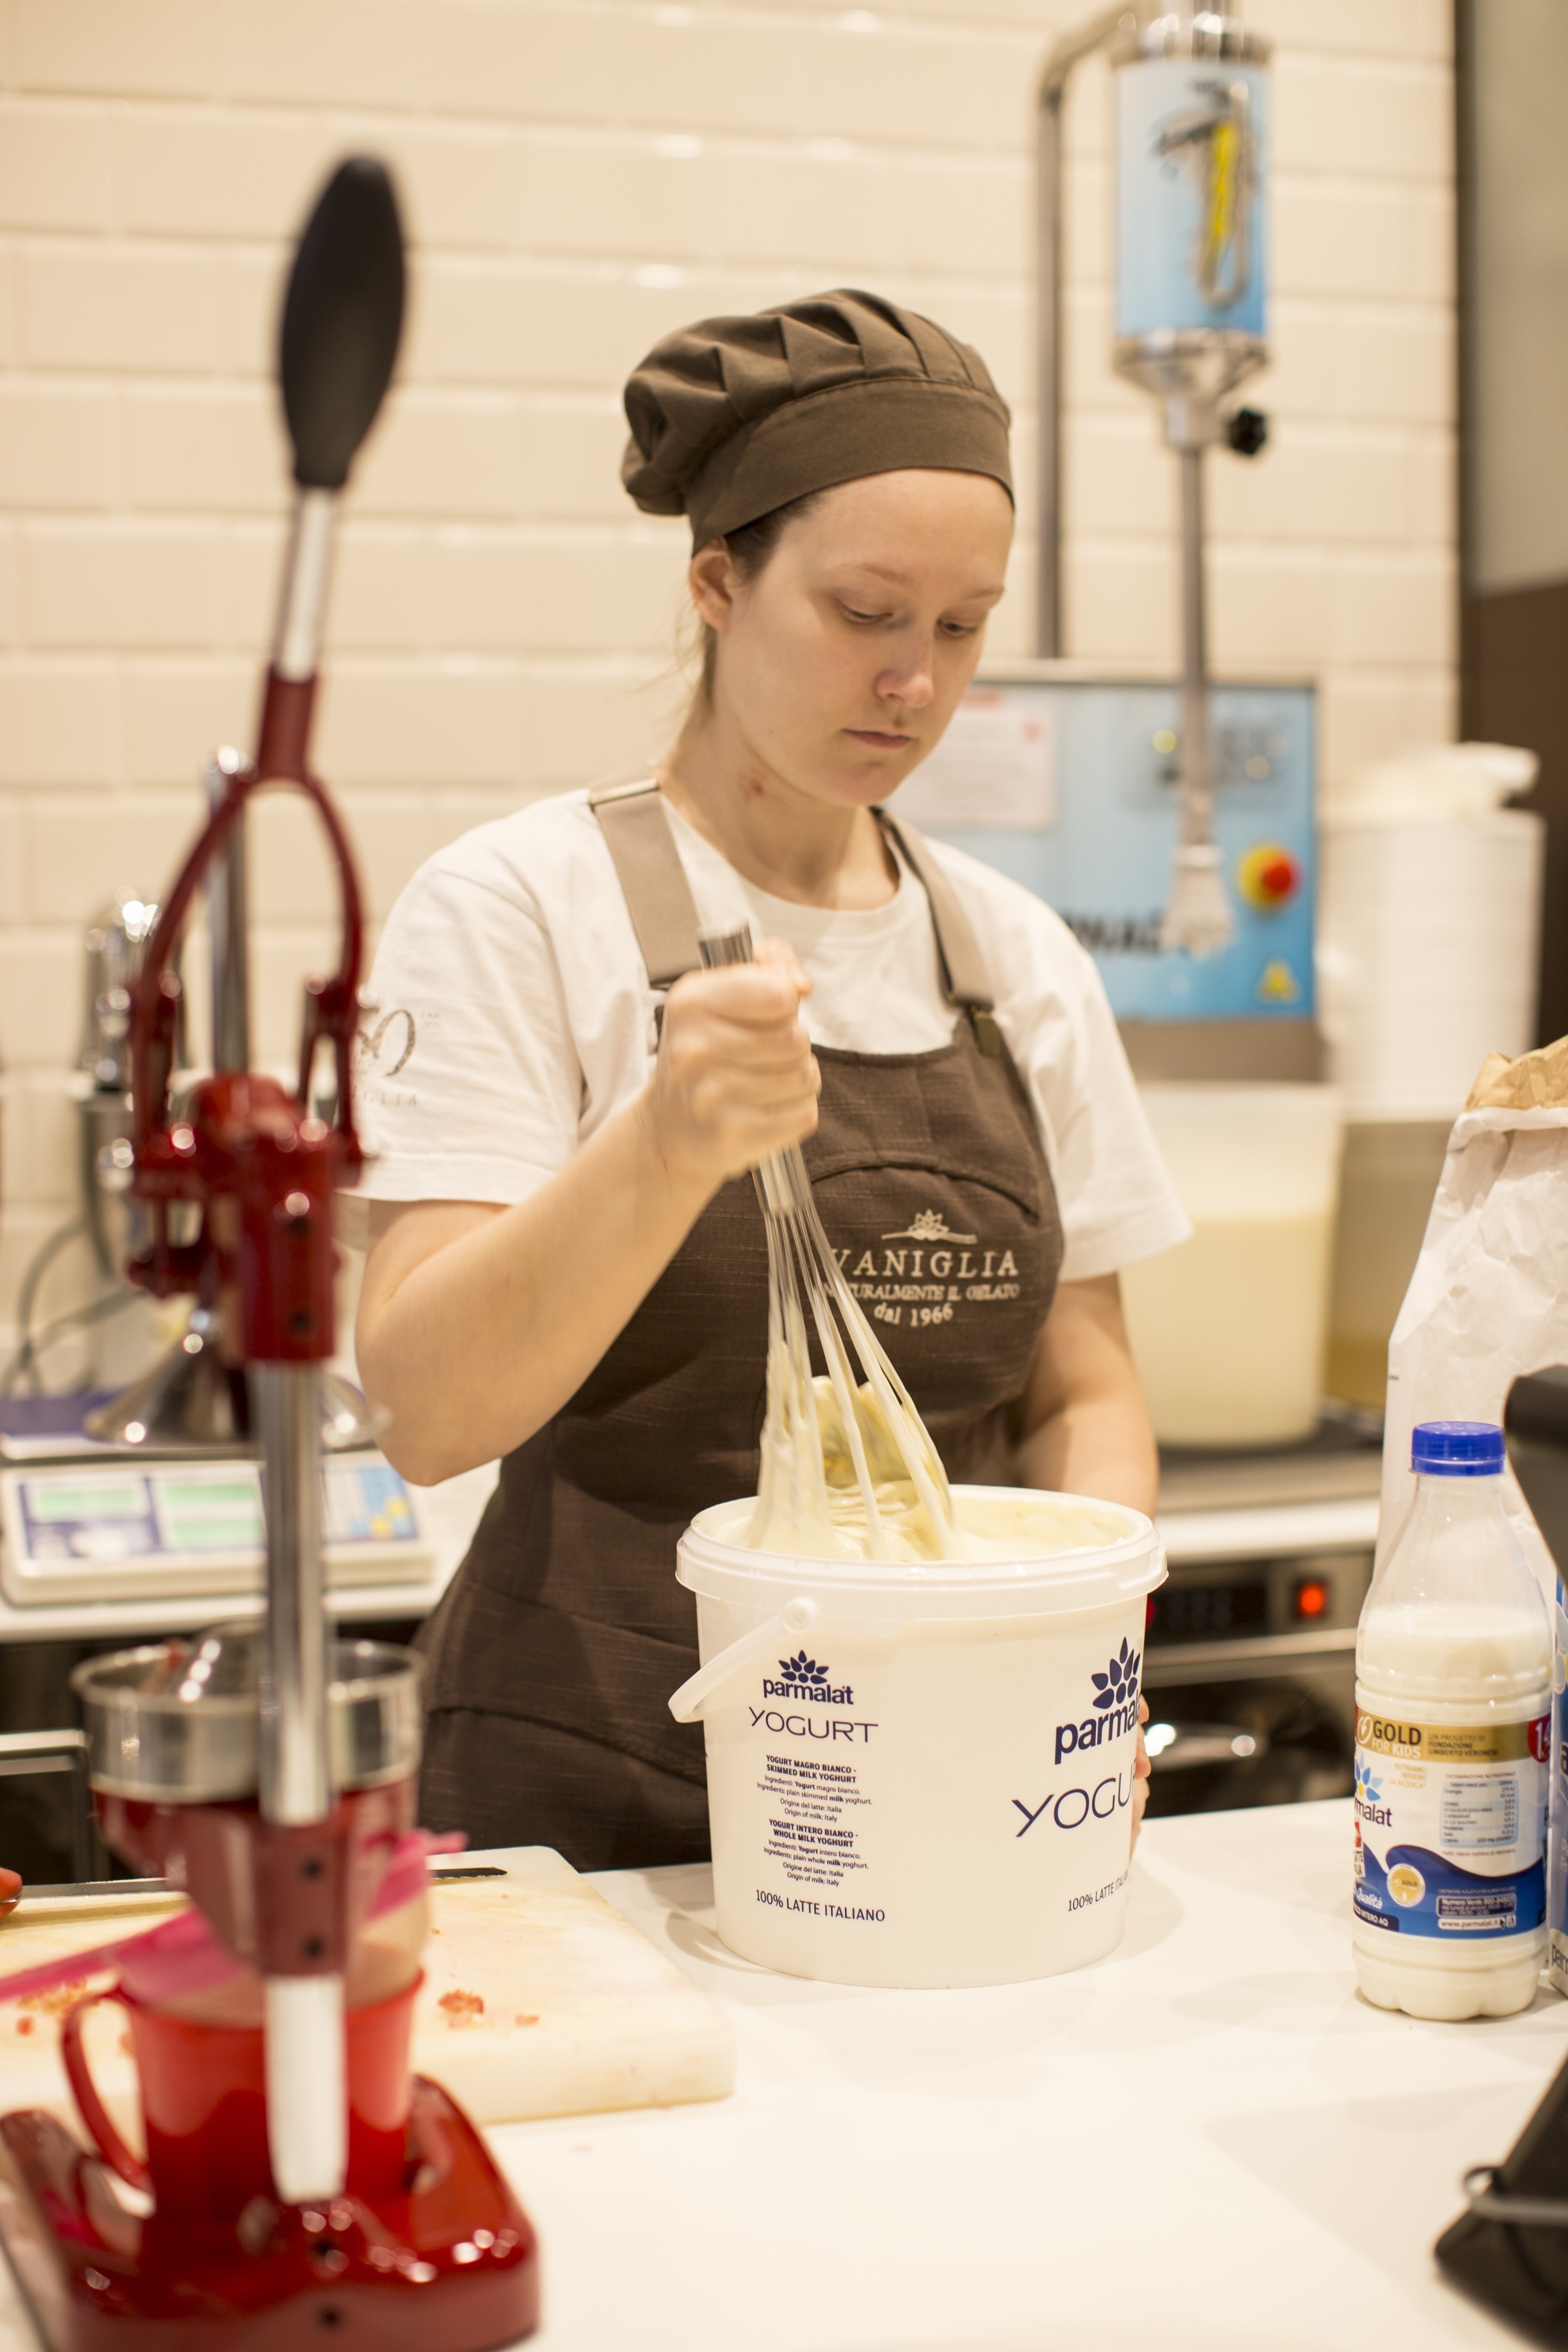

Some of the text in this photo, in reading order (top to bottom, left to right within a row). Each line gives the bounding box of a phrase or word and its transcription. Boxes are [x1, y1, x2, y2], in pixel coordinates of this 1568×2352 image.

[823, 1282, 1021, 1301] NTURALMENTE IL GELATO
[874, 1301, 953, 1327] dal 1966
[763, 1679, 854, 1705] parmalat
[749, 1706, 879, 1742] YOGURT
[1373, 1720, 1422, 1745] GOLD
[1371, 1738, 1421, 1759] FOR KIDS
[767, 1754, 792, 1766] YOGURT
[794, 1760, 820, 1770] MAGRO
[822, 1764, 852, 1773] BIANCO
[767, 1764, 856, 1783] SKIMMED MILK YOGHURT
[764, 1774, 794, 1786] Ingredienti:
[795, 1781, 815, 1790] Yogurt
[817, 1785, 836, 1793] magro
[757, 1782, 785, 1794] Ingredients:
[787, 1788, 800, 1797] plain
[801, 1791, 828, 1800] skimmed
[845, 1797, 872, 1805] yoghurt.
[780, 1798, 800, 1808] Origine
[785, 1808, 801, 1817] Origin
[824, 1815, 837, 1823] Italy
[769, 1818, 794, 1830] YOGURT
[797, 1824, 823, 1835] INTERO
[825, 1829, 854, 1838] BIANCO
[768, 1839, 797, 1851] Ingredienti:
[798, 1845, 818, 1854] Yogurt
[773, 1829, 854, 1847] WHOLE MILK YOGHURT
[763, 1847, 792, 1859] Ingredients:
[793, 1853, 807, 1861] plain
[842, 1861, 869, 1869] yoghurt.
[783, 1862, 803, 1872] Origine
[787, 1872, 804, 1881] Origin
[826, 1879, 840, 1887] Italy
[756, 1889, 885, 1921] 100% LATTE ITALIANO
[1068, 1892, 1093, 1912] 100%
[1095, 1882, 1114, 1902] LATTE
[1357, 1887, 1383, 1910] Qualità
[1361, 1910, 1378, 1924] INTERO
[1379, 1917, 1388, 1927] AQ
[1441, 1919, 1498, 1929] www.parmalat.it
